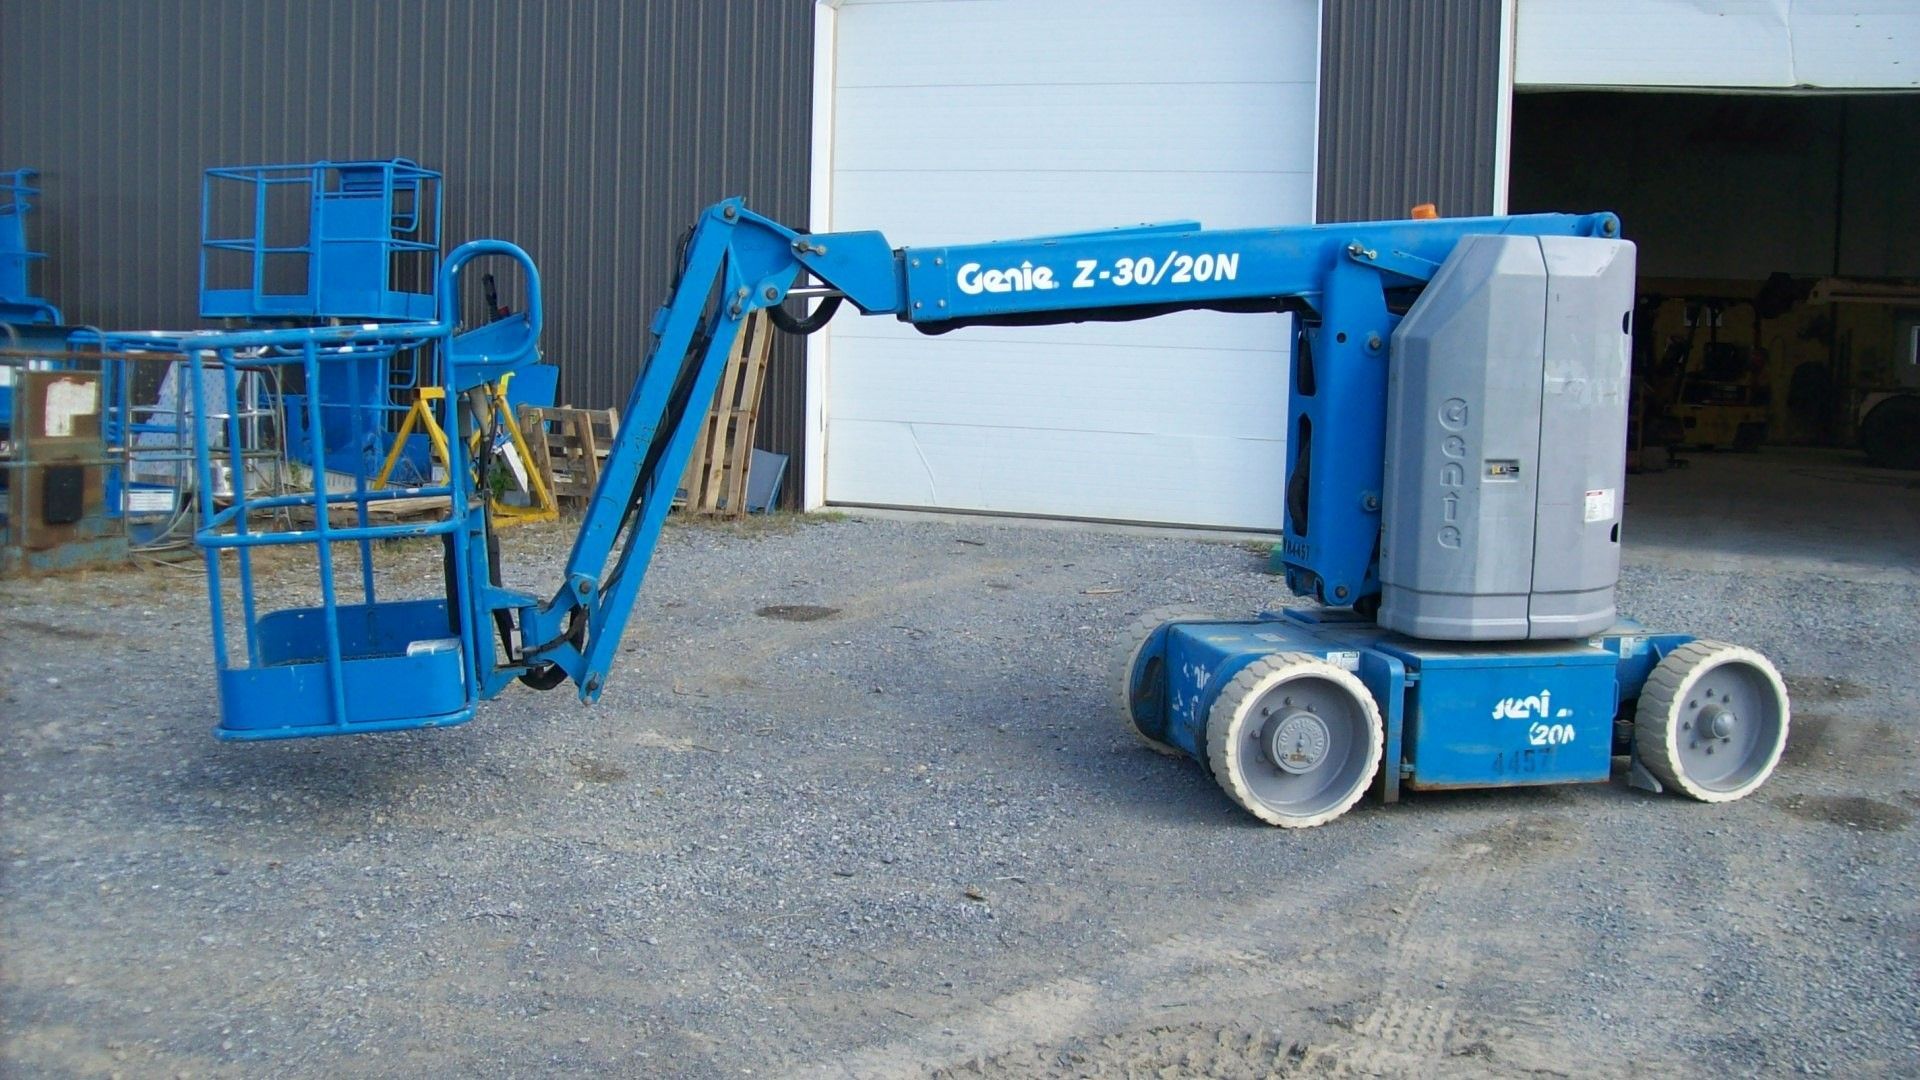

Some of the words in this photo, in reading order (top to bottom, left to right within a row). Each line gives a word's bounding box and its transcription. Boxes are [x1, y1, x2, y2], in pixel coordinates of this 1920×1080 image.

[957, 259, 1056, 295] Genie
[1072, 251, 1240, 288] Z-30/20N
[1493, 747, 1553, 776] 4457
